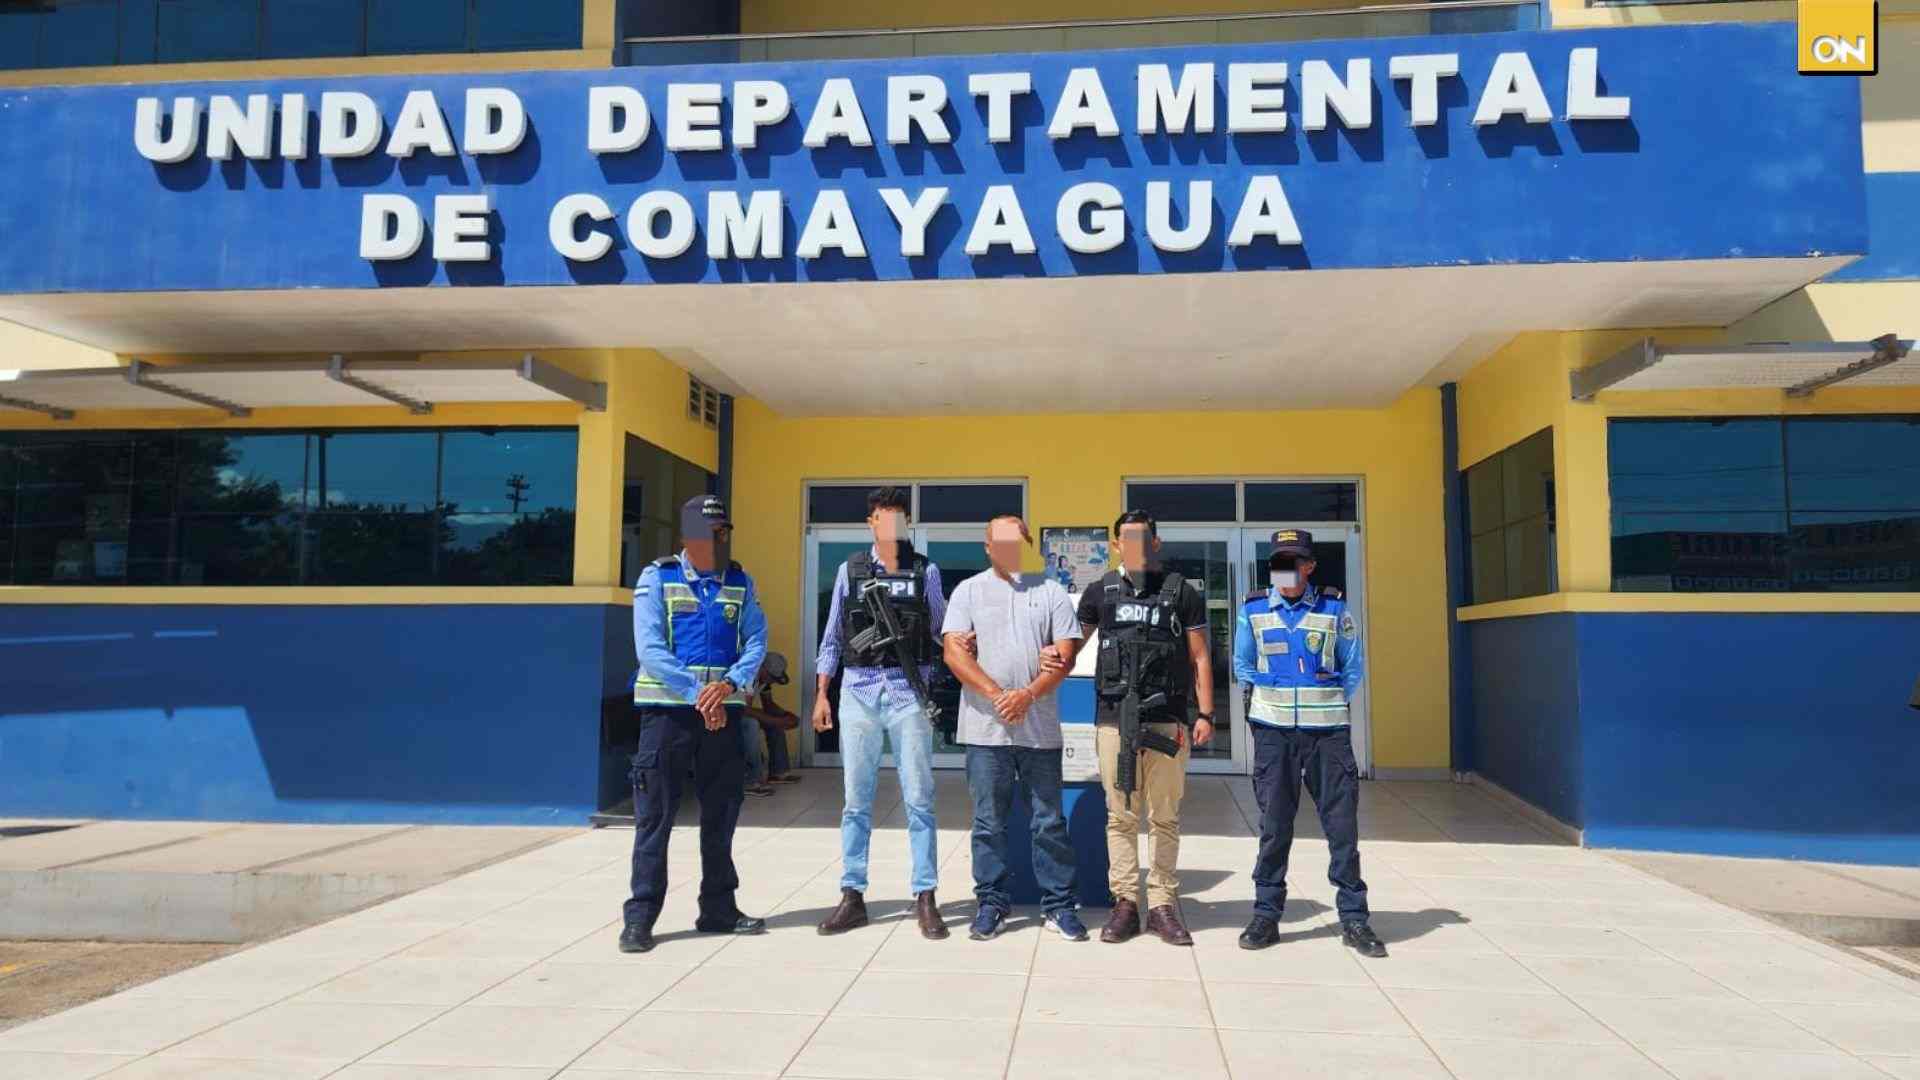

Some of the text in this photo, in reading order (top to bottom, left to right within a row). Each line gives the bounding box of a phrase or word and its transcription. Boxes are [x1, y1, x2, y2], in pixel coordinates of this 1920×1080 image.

[134, 47, 1632, 163] UNIDAD DEPARTAMENTAL
[360, 174, 1303, 263] DE COMAYAGUA
[877, 580, 915, 597] PI
